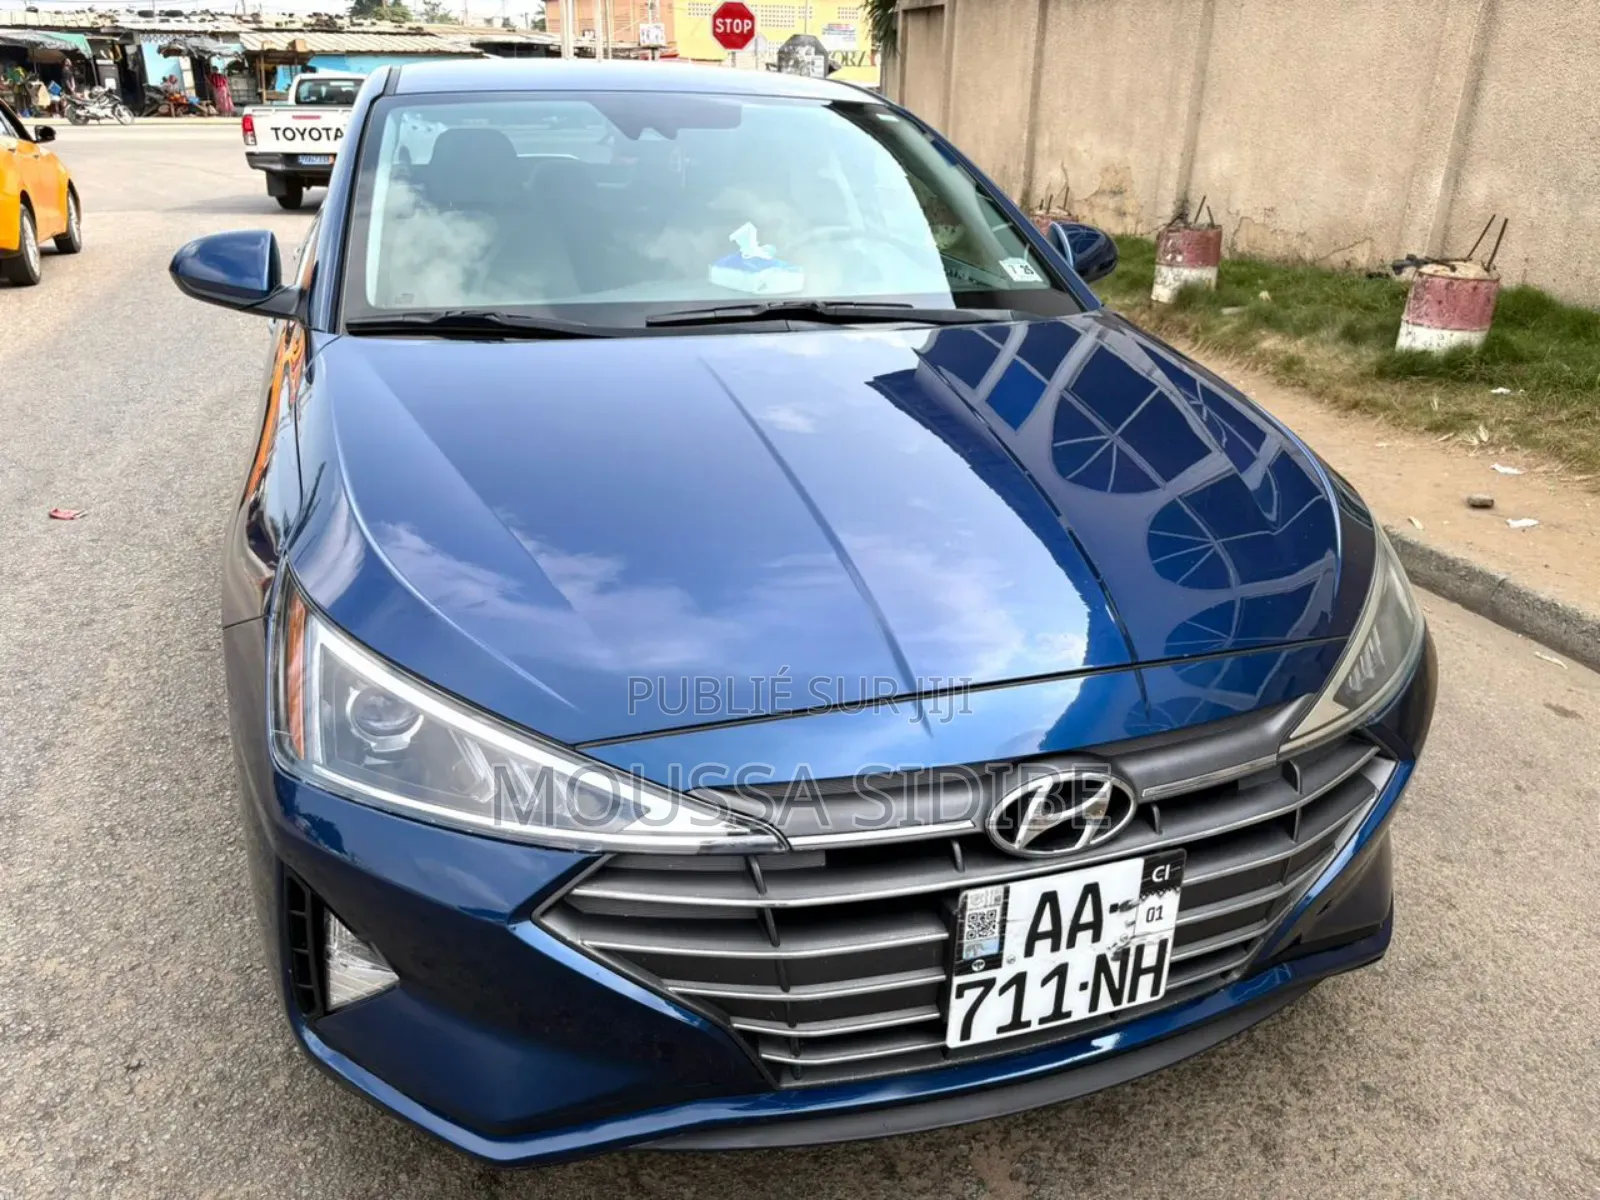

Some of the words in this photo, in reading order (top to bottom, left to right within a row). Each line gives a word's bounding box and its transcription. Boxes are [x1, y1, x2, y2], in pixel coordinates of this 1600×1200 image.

[716, 18, 752, 34] STOP
[270, 127, 344, 141] TOYOTA
[1151, 864, 1171, 882] CI
[1145, 905, 1164, 922] 01
